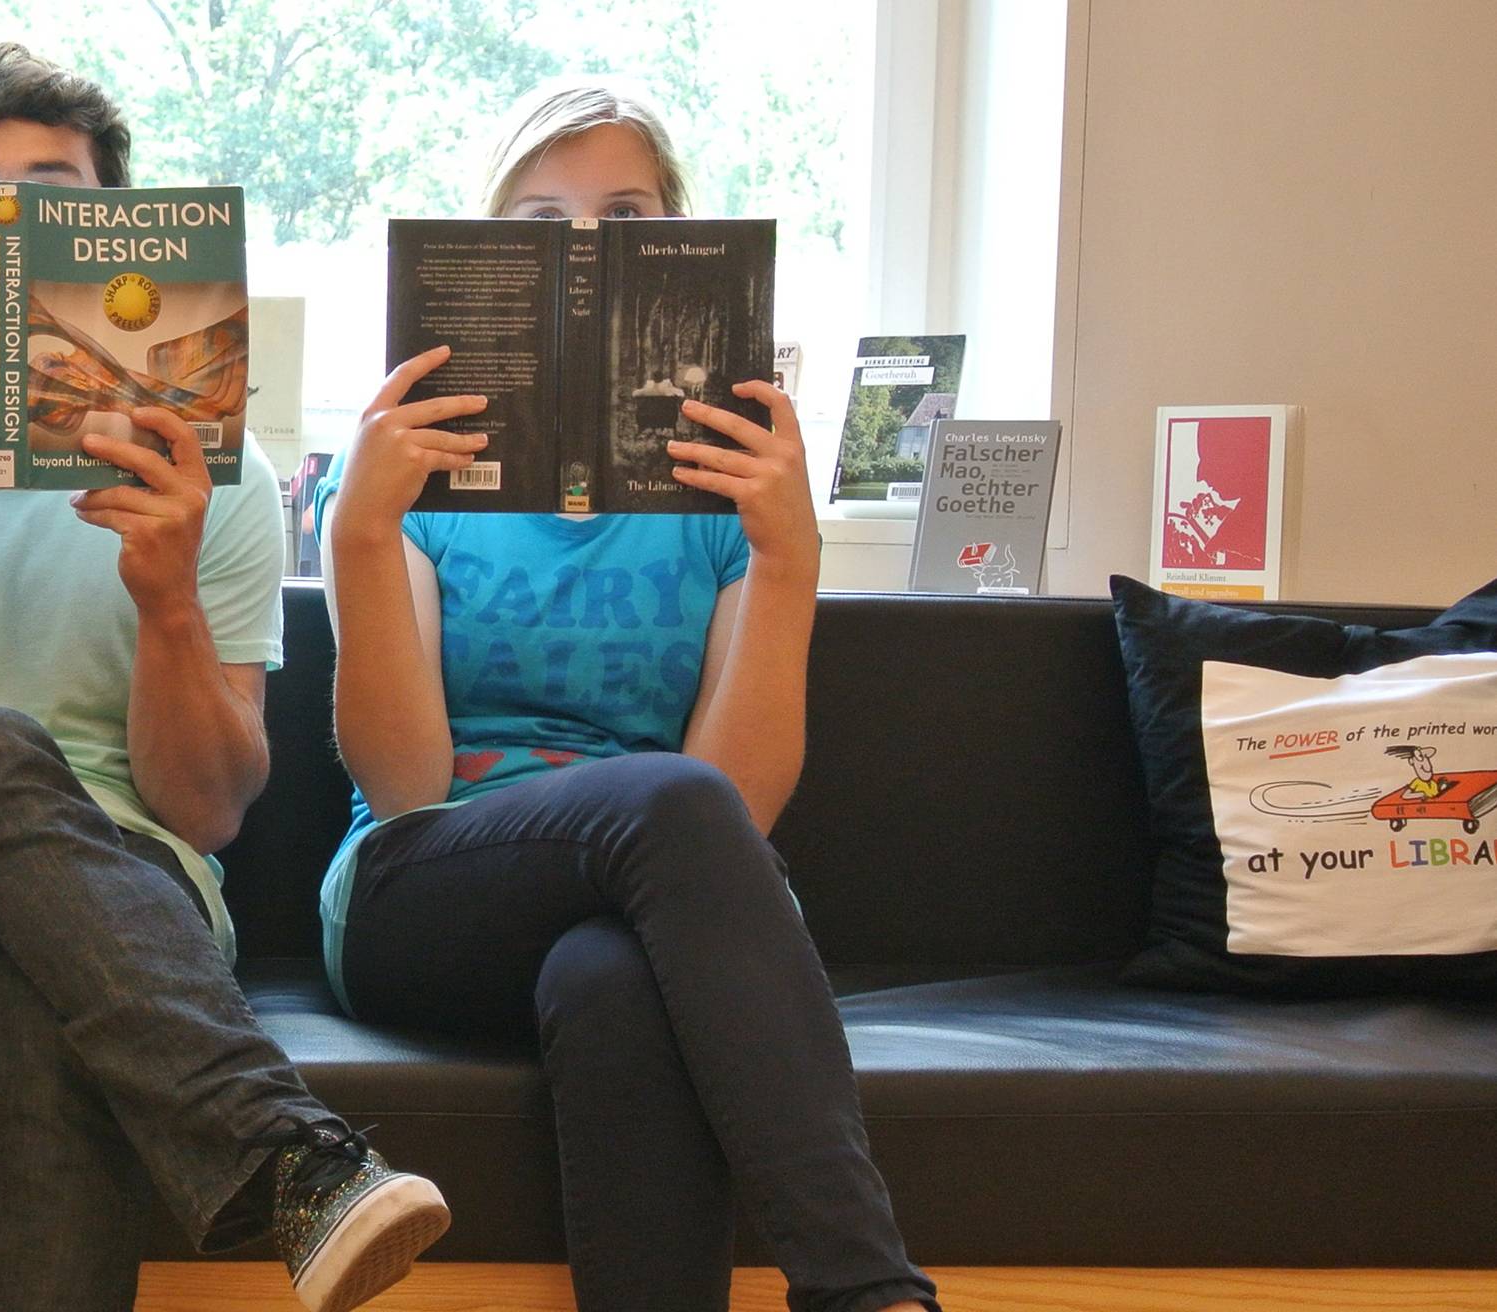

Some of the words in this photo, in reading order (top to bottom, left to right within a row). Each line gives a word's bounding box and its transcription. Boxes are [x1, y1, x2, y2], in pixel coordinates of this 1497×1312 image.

[39, 198, 231, 228] INTERACTION
[73, 237, 188, 262] DESIGN
[638, 244, 677, 256] Alberto
[680, 243, 725, 257] Manguel
[105, 276, 128, 303] SHARP
[5, 236, 21, 362] INTERACTION
[865, 370, 917, 380] Goetheruh
[5, 371, 20, 442] DESIGN
[945, 434, 989, 443] Charles
[995, 434, 1047, 444] Lewinsky
[32, 455, 73, 468] beyond
[942, 445, 1044, 462] Falscher
[940, 462, 986, 481] Mao,
[627, 480, 645, 490] The
[961, 479, 1039, 496] echter
[936, 496, 1015, 513] Goethe
[1166, 572, 1197, 582] Reinhard
[443, 552, 691, 629] FAIRY
[1237, 737, 1267, 752] The
[1274, 730, 1338, 749] POWER
[1346, 726, 1367, 742] of
[1373, 724, 1400, 738] the
[1407, 722, 1465, 740] printed
[1248, 848, 1284, 873] at
[1300, 848, 1373, 880] your
